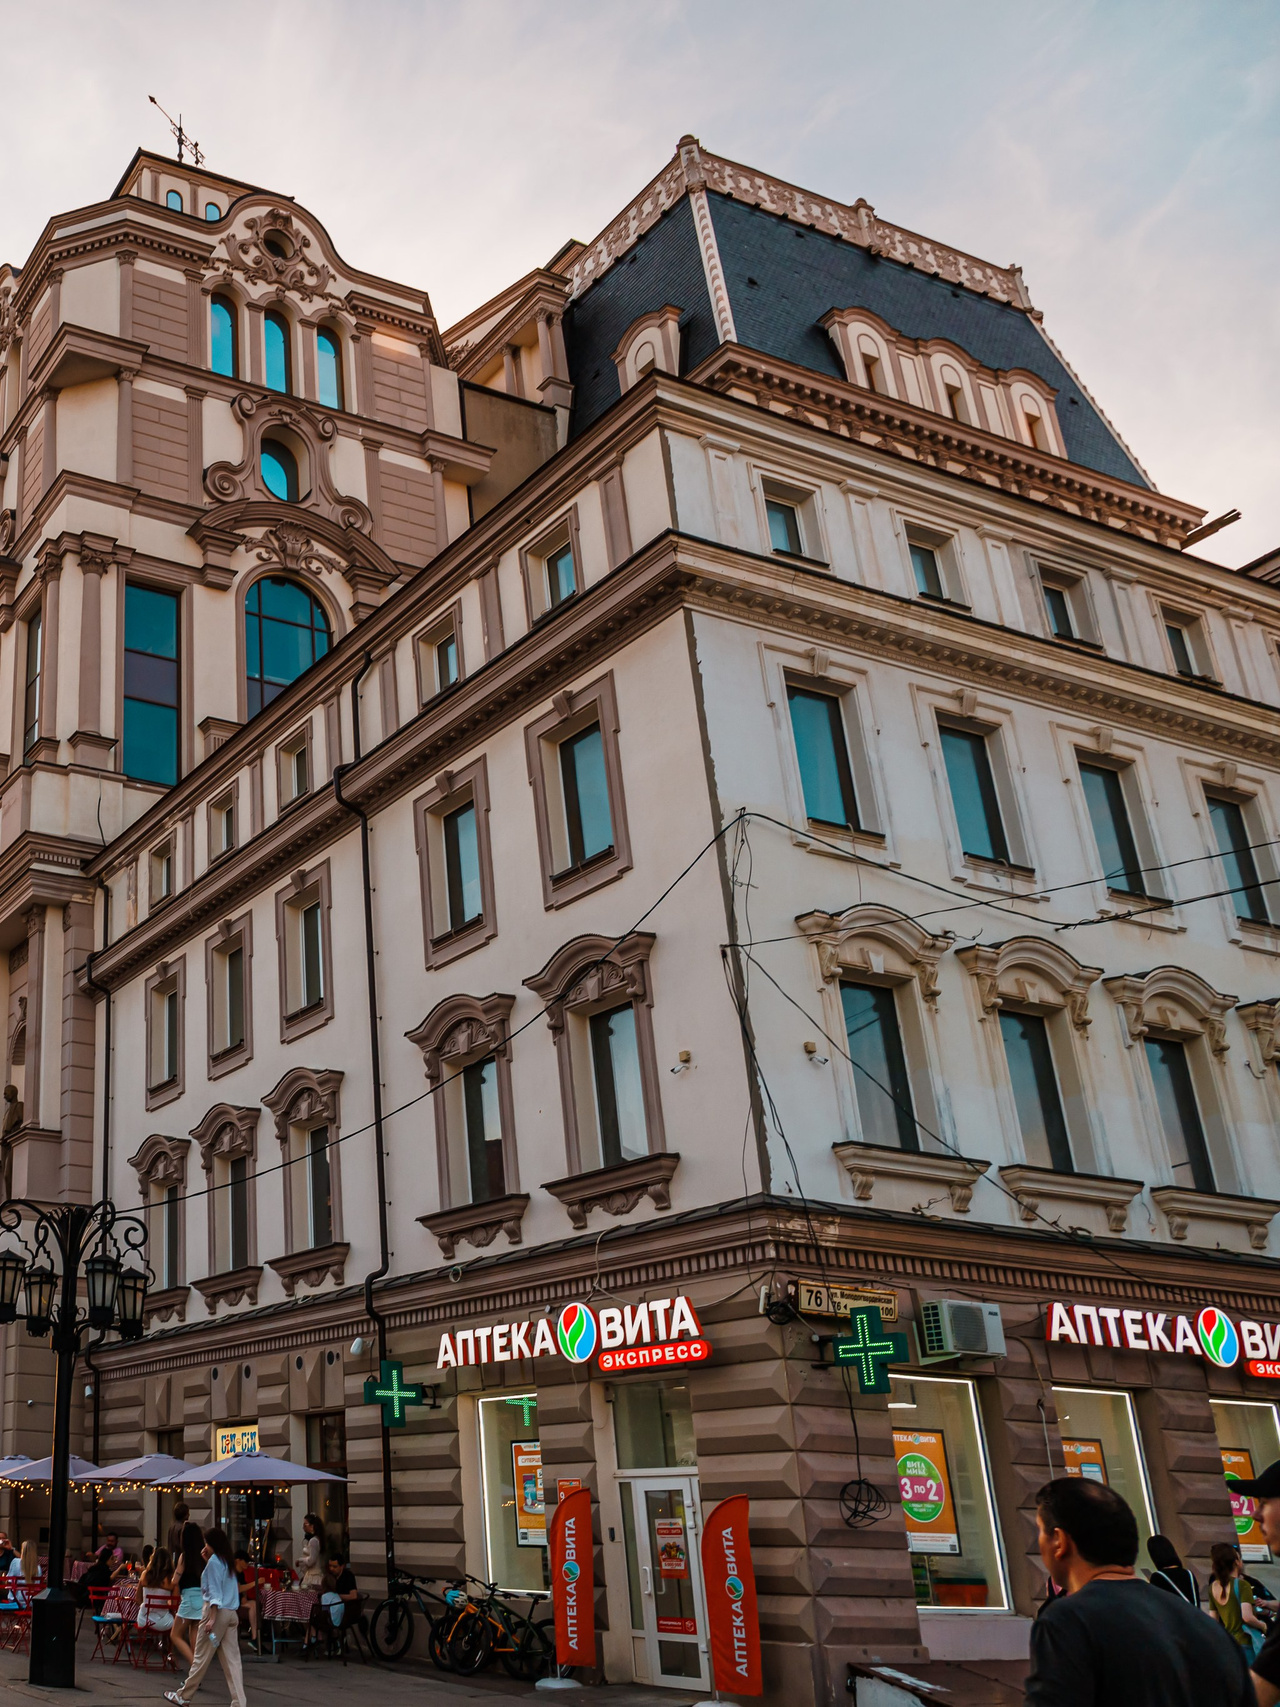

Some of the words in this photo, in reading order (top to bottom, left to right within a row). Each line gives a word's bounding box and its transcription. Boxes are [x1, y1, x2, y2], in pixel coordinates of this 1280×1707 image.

[806, 1289, 823, 1307] 76
[881, 1306, 894, 1317] 100
[436, 1318, 558, 1369] АПТЕКА
[598, 1296, 701, 1348] ВИТА
[1049, 1302, 1203, 1355] АПТЕКА
[603, 1343, 703, 1369] ЭКСПРЕСС
[906, 1461, 926, 1469] ВИТА
[901, 1478, 913, 1499] 3
[914, 1485, 926, 1494] по
[927, 1479, 939, 1501] 2
[1240, 1495, 1251, 1515] 2
[565, 1517, 576, 1560] ВИТА
[722, 1526, 737, 1575] ВИТА
[566, 1582, 578, 1650] АПТЕКА
[731, 1600, 749, 1678] АПТЕКА
